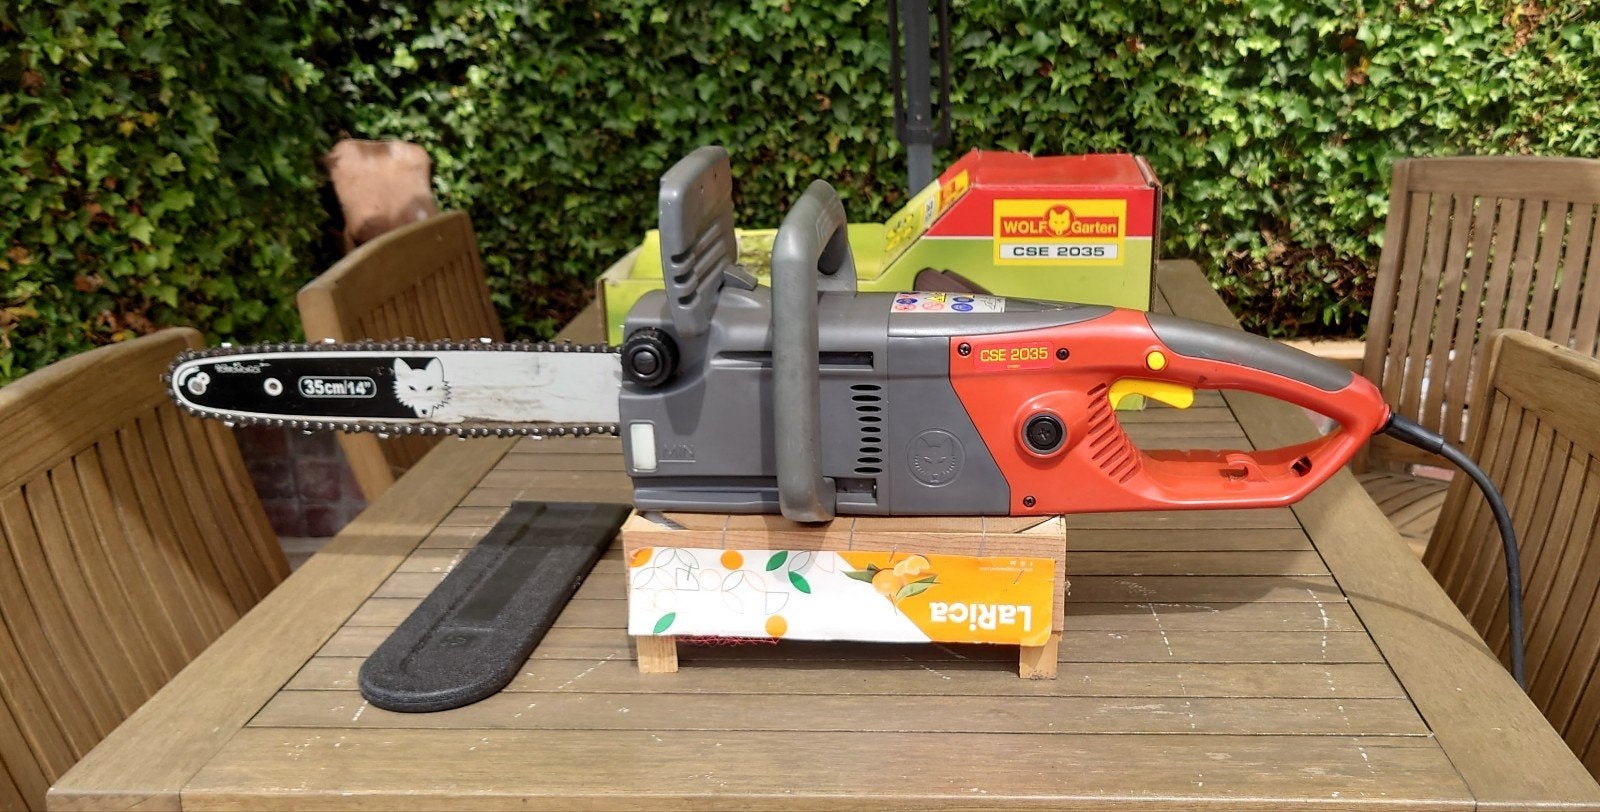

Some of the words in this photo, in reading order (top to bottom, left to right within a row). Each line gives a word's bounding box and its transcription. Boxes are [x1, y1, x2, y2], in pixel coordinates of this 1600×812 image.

[1003, 220, 1048, 234] WOLF
[1070, 220, 1117, 235] Garten
[1012, 246, 1050, 257] CSE
[1056, 246, 1105, 257] 2035
[979, 348, 1007, 362] CSE
[1010, 346, 1049, 361] 2035
[662, 443, 696, 459] MIN
[928, 601, 1033, 633] LaRica
